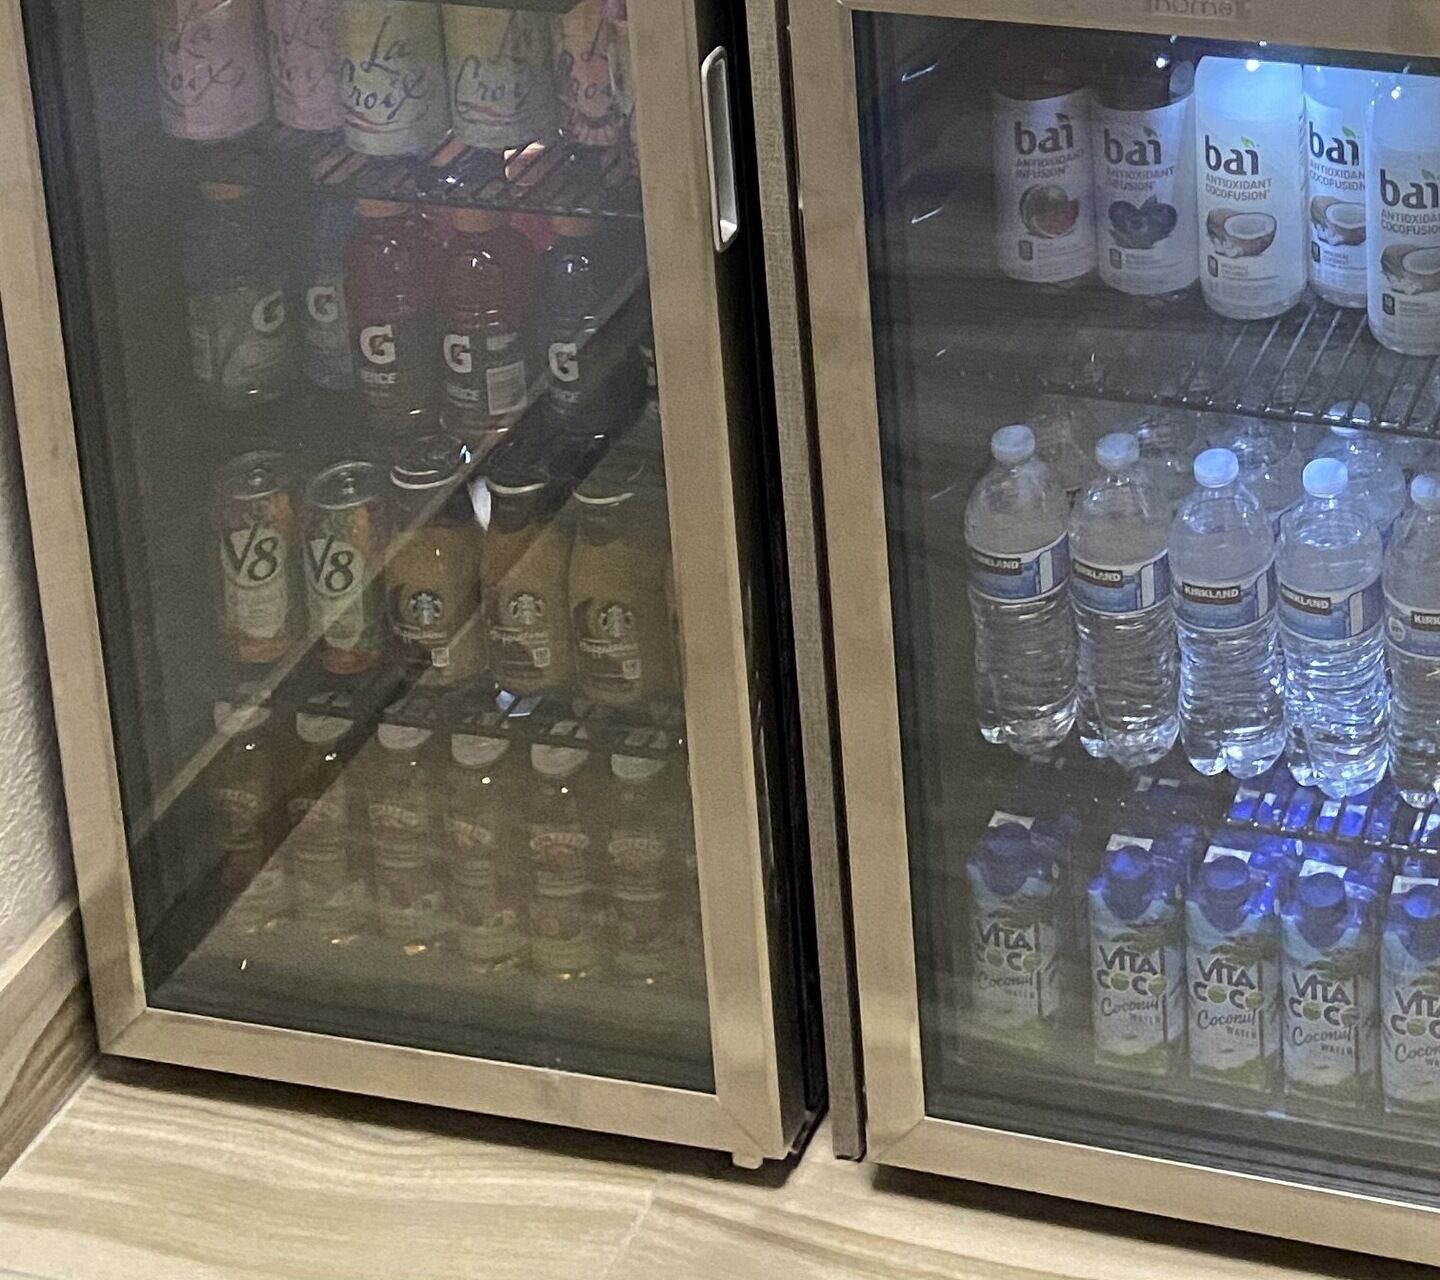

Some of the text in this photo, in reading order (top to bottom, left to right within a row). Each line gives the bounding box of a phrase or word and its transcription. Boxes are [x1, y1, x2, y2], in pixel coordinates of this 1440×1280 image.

[1014, 119, 1074, 156] bai
[1103, 126, 1162, 167] bai
[1204, 134, 1260, 176] bai
[1309, 120, 1360, 166] bai
[1204, 172, 1273, 191] ANTIOXIDANT
[1205, 182, 1268, 201] COCOFUSION
[1379, 168, 1440, 210] bai
[307, 286, 340, 322] G
[360, 324, 397, 364] G
[443, 333, 473, 374] G
[548, 342, 580, 382] G
[225, 536, 279, 581] V8
[304, 541, 356, 593] V8
[1184, 585, 1239, 600] KIRKLAND
[1100, 944, 1158, 976] VITA
[1196, 957, 1257, 990] VITA
[1101, 997, 1159, 1017] Coconut
[1292, 971, 1351, 1006] VITA
[1196, 1009, 1256, 1029] Coconut
